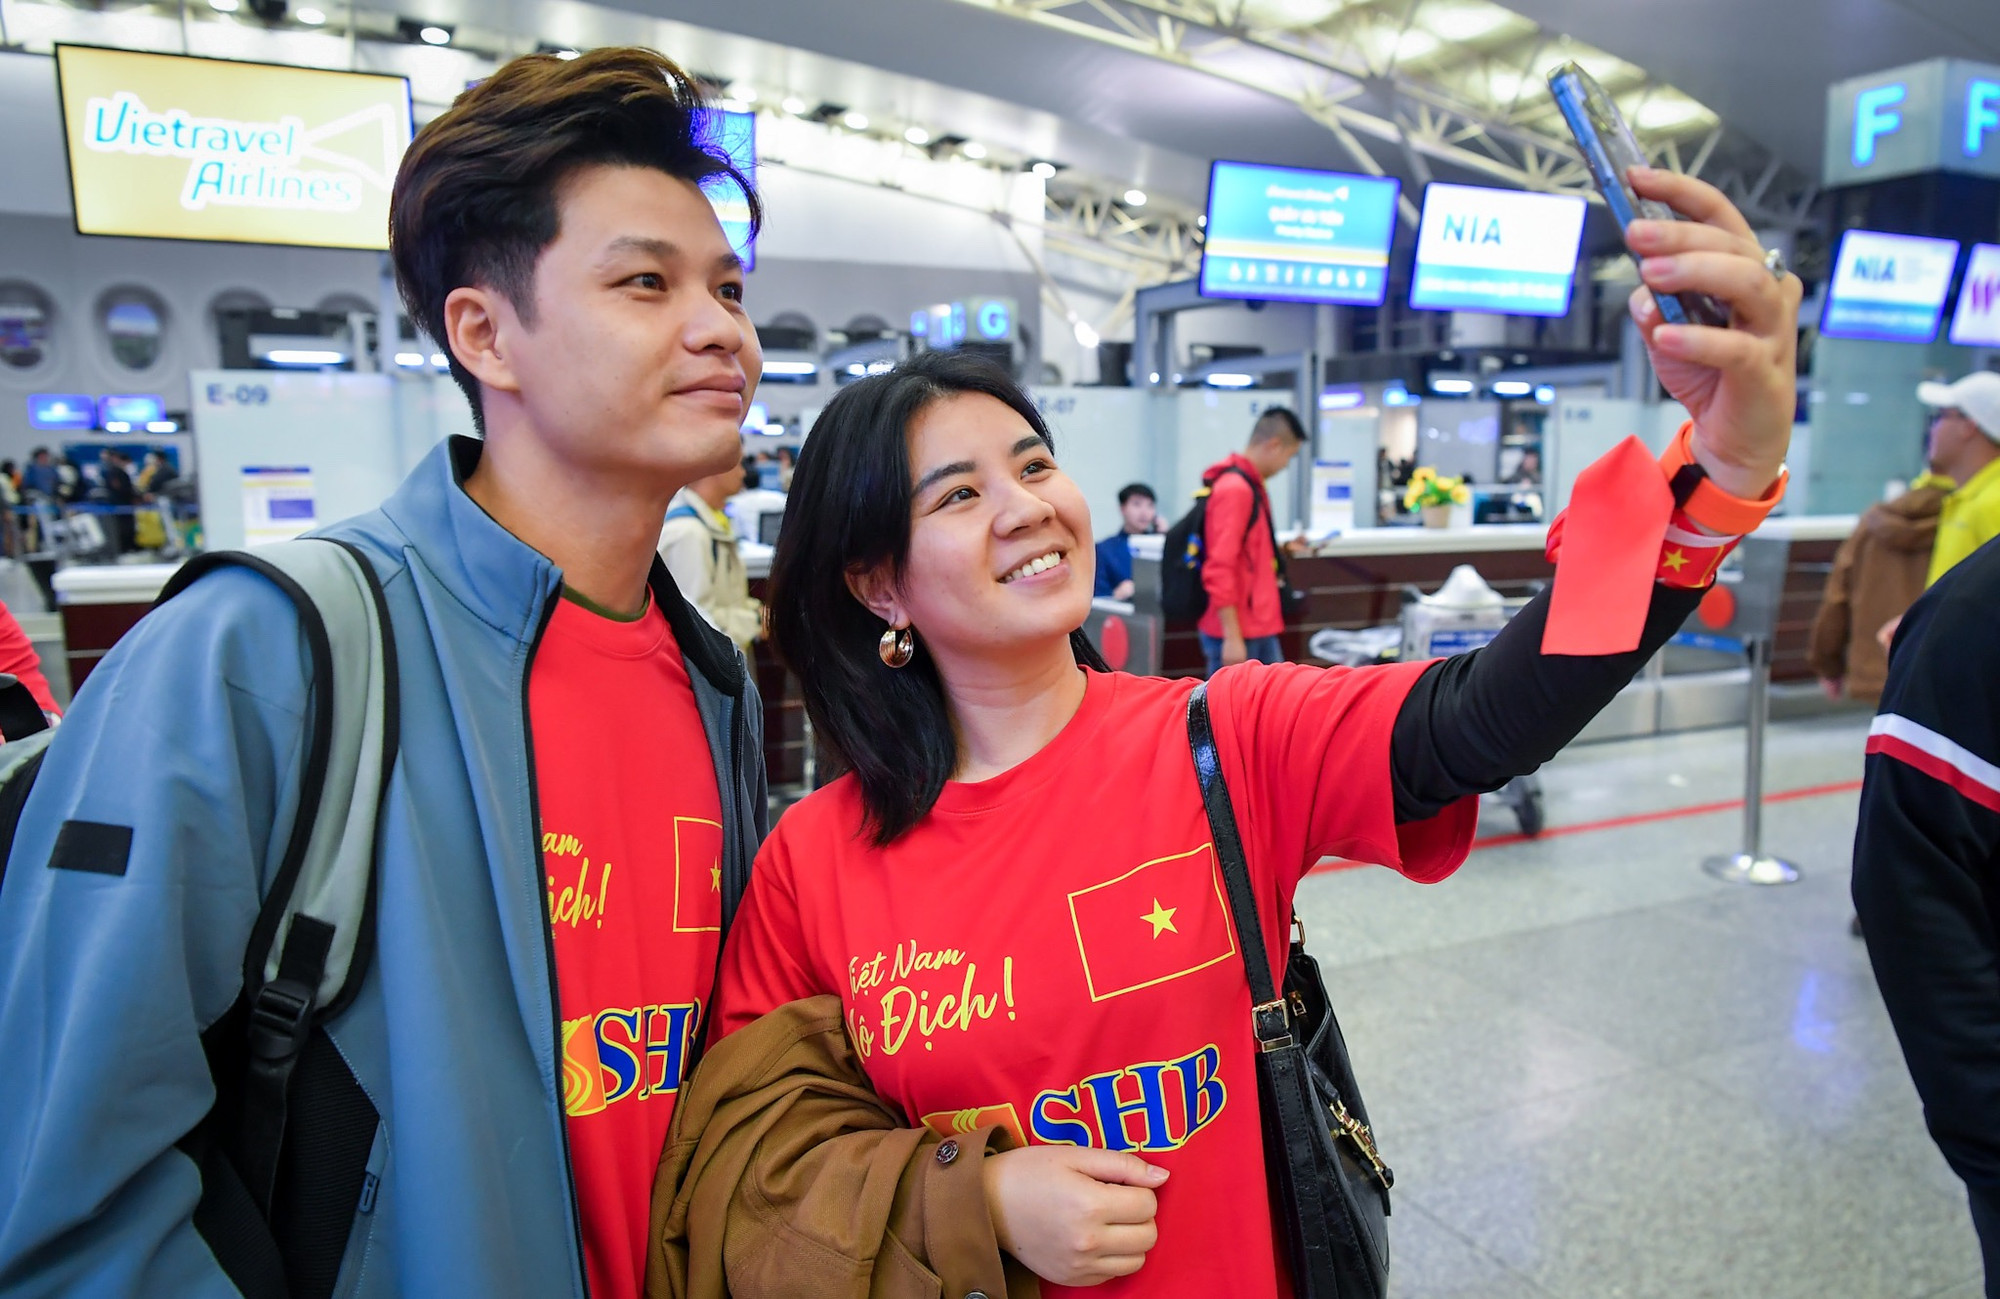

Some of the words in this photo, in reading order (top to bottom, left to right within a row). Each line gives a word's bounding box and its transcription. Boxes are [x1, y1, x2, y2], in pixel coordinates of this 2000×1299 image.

[95, 101, 294, 156] Vietravel
[1852, 82, 1907, 167] F
[1963, 78, 2000, 156] F
[191, 160, 351, 202] Airlines
[1443, 213, 1502, 245] NIA
[977, 301, 1010, 340] G
[206, 383, 270, 407] E-09
[541, 826, 583, 857] am
[890, 939, 966, 983] Nam
[1029, 1043, 1228, 1153] SHB
